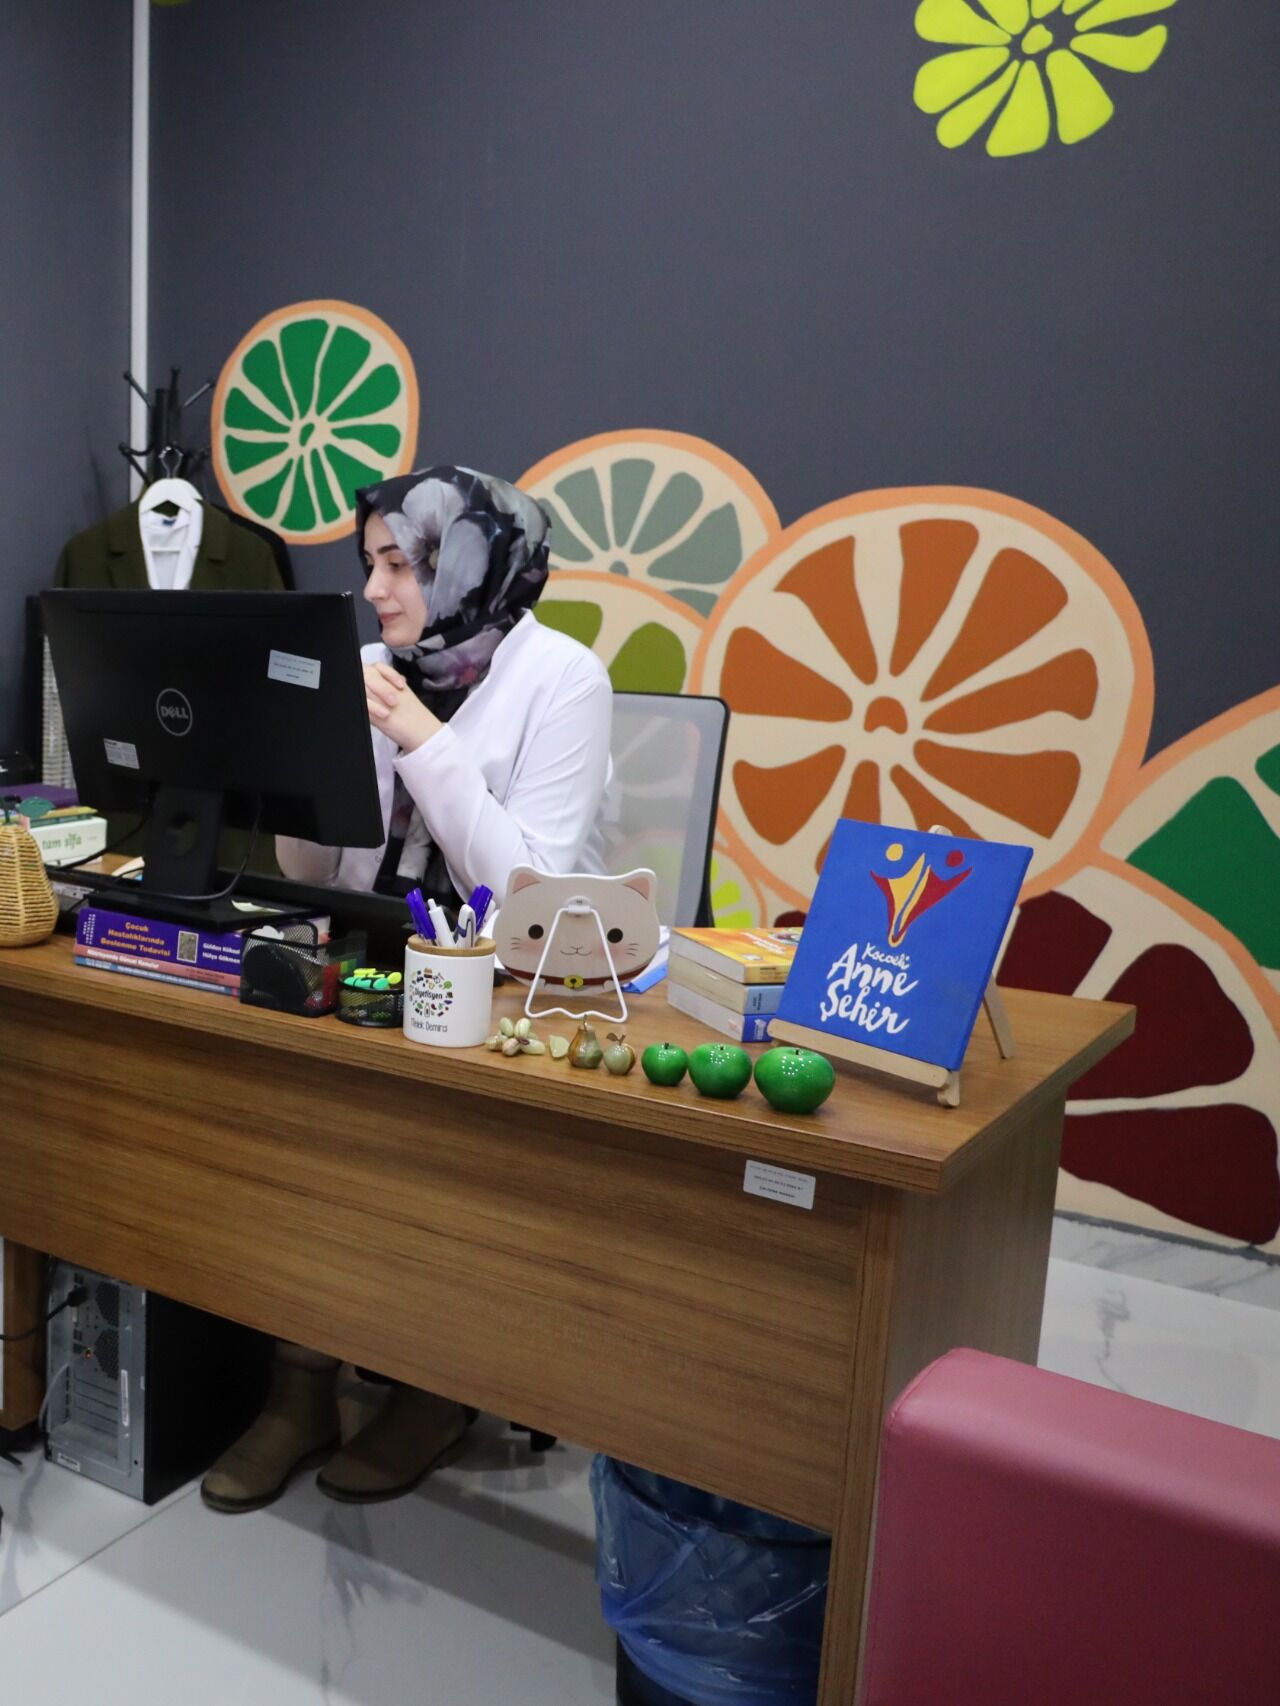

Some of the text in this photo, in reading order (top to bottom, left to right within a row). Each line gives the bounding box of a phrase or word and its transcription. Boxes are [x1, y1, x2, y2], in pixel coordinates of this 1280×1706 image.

[160, 705, 189, 719] DELL
[125, 921, 149, 933] Çocuk
[861, 941, 910, 970] Kocaeli
[826, 943, 919, 996] Anne
[414, 988, 443, 1000] Diyetisyen
[820, 978, 910, 1034] Şehir
